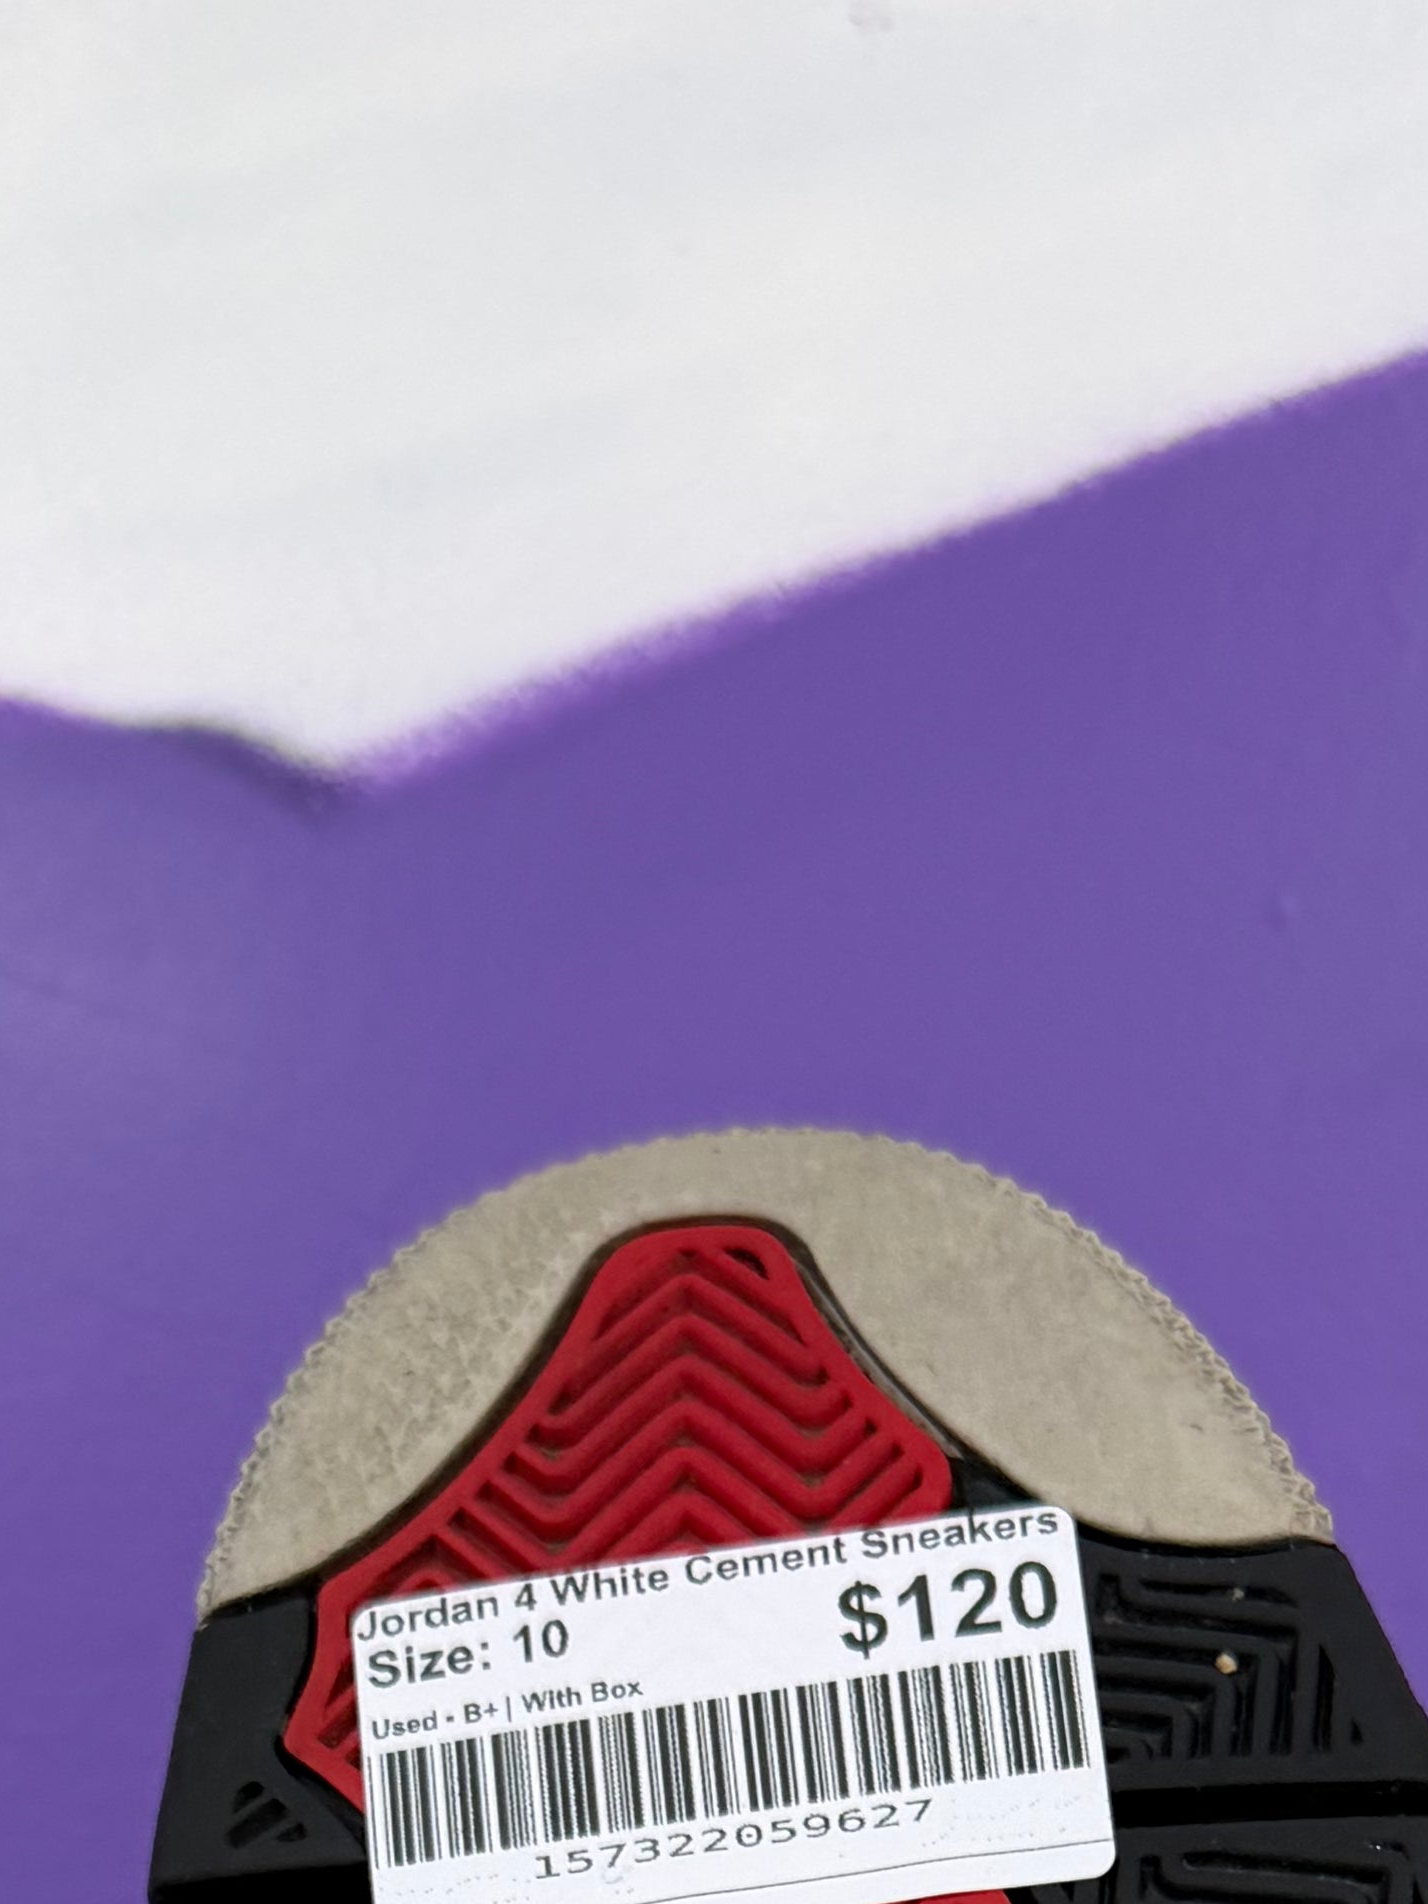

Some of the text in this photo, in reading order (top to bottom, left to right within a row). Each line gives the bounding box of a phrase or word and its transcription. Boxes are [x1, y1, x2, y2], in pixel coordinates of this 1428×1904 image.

[357, 1509, 1059, 1642] Jordan 4 White Cement Sneakers
[837, 1560, 1058, 1660] $120
[368, 1619, 569, 1688] Size: 10
[372, 1710, 438, 1740] Used
[522, 1686, 582, 1714] With
[591, 1680, 644, 1703] Box
[535, 1798, 934, 1880] 157322059627
